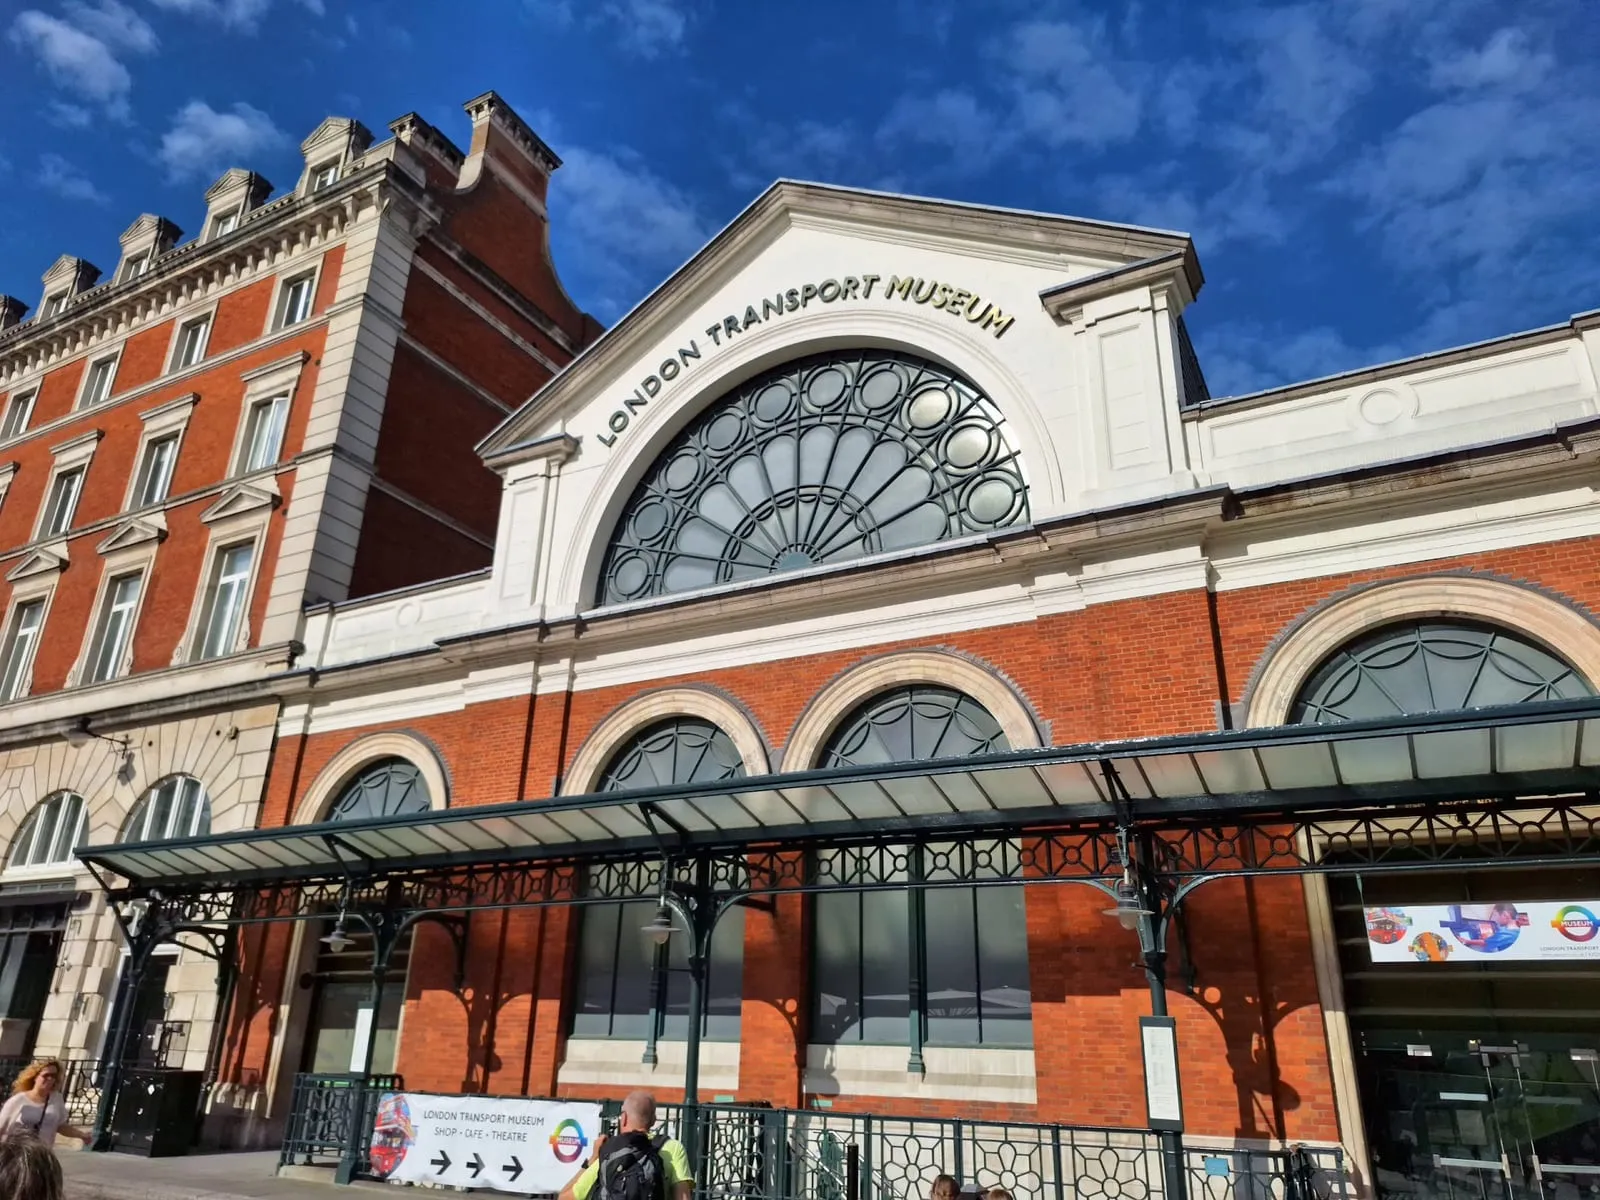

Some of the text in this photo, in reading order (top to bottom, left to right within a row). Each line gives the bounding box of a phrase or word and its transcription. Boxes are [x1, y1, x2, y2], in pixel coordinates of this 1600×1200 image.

[597, 274, 1016, 447] LONDON TRANSPORT MUSEUM
[423, 1110, 545, 1126] LONDON TRANSPORT MUSEUM
[434, 1126, 457, 1137] SHOP
[491, 1130, 528, 1142] THEATRE
[557, 1136, 580, 1144] MUSEUM
